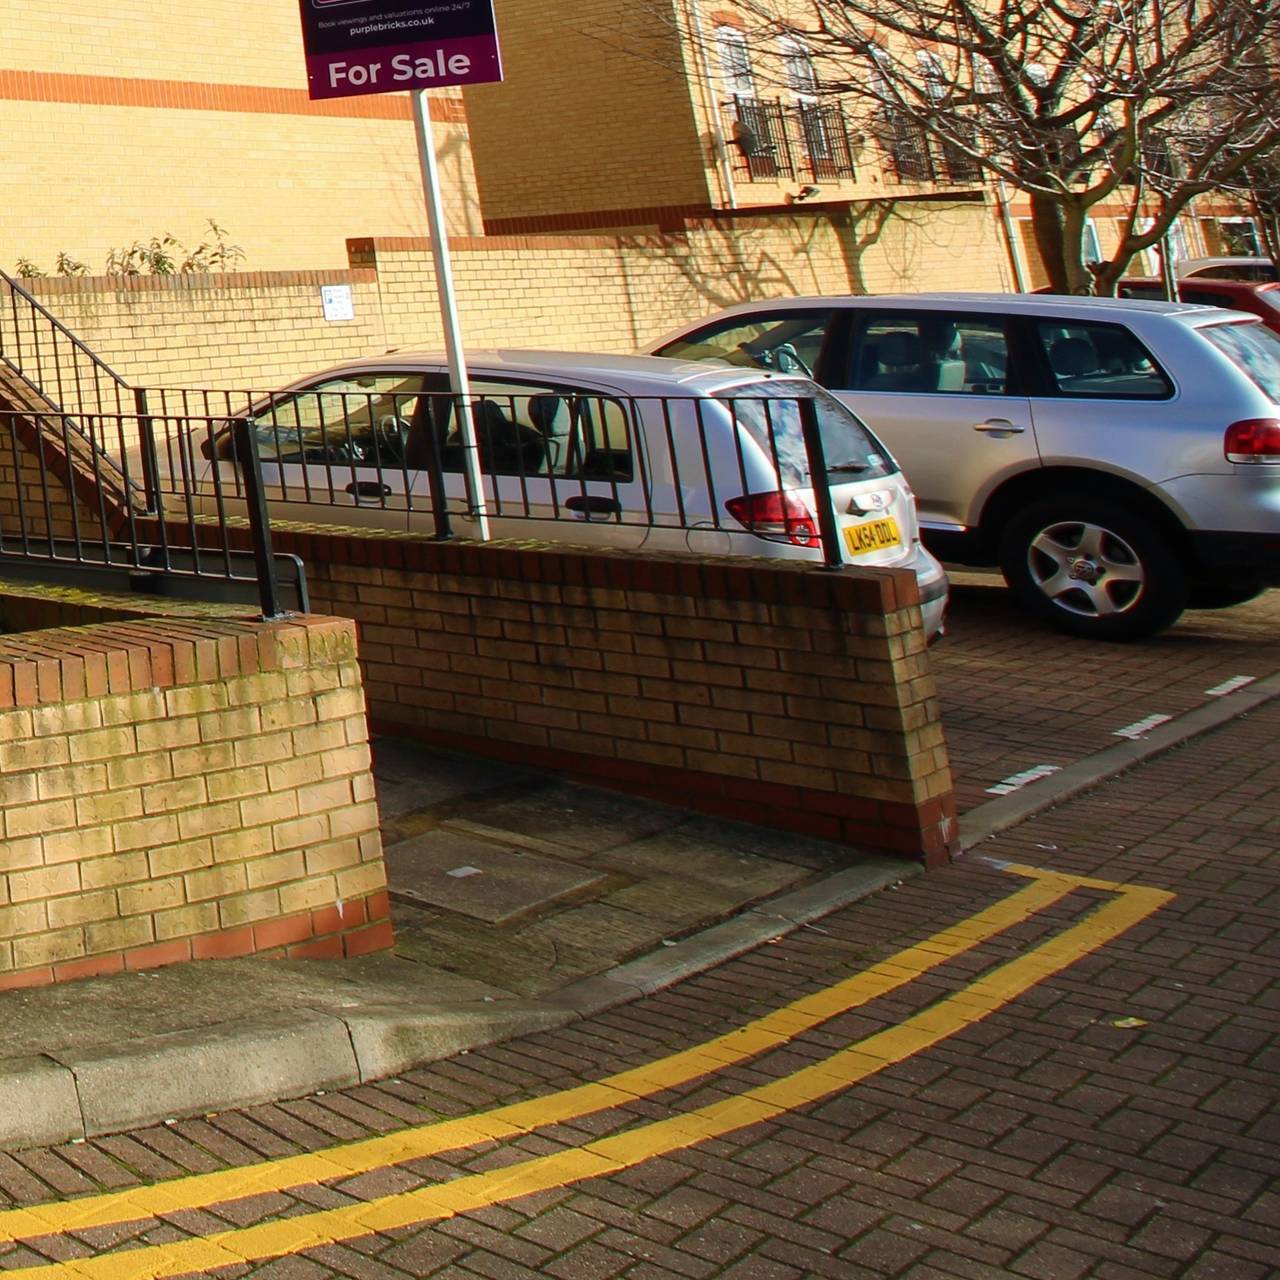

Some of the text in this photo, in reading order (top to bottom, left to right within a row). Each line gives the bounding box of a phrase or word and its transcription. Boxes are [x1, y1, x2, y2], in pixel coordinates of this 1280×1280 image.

[369, 11, 383, 21] and
[383, 7, 424, 20] valuations
[424, 4, 450, 15] online
[451, 1, 471, 12] 24/7
[349, 16, 435, 37] purplebricks.co.uk
[328, 48, 472, 88] For Sale
